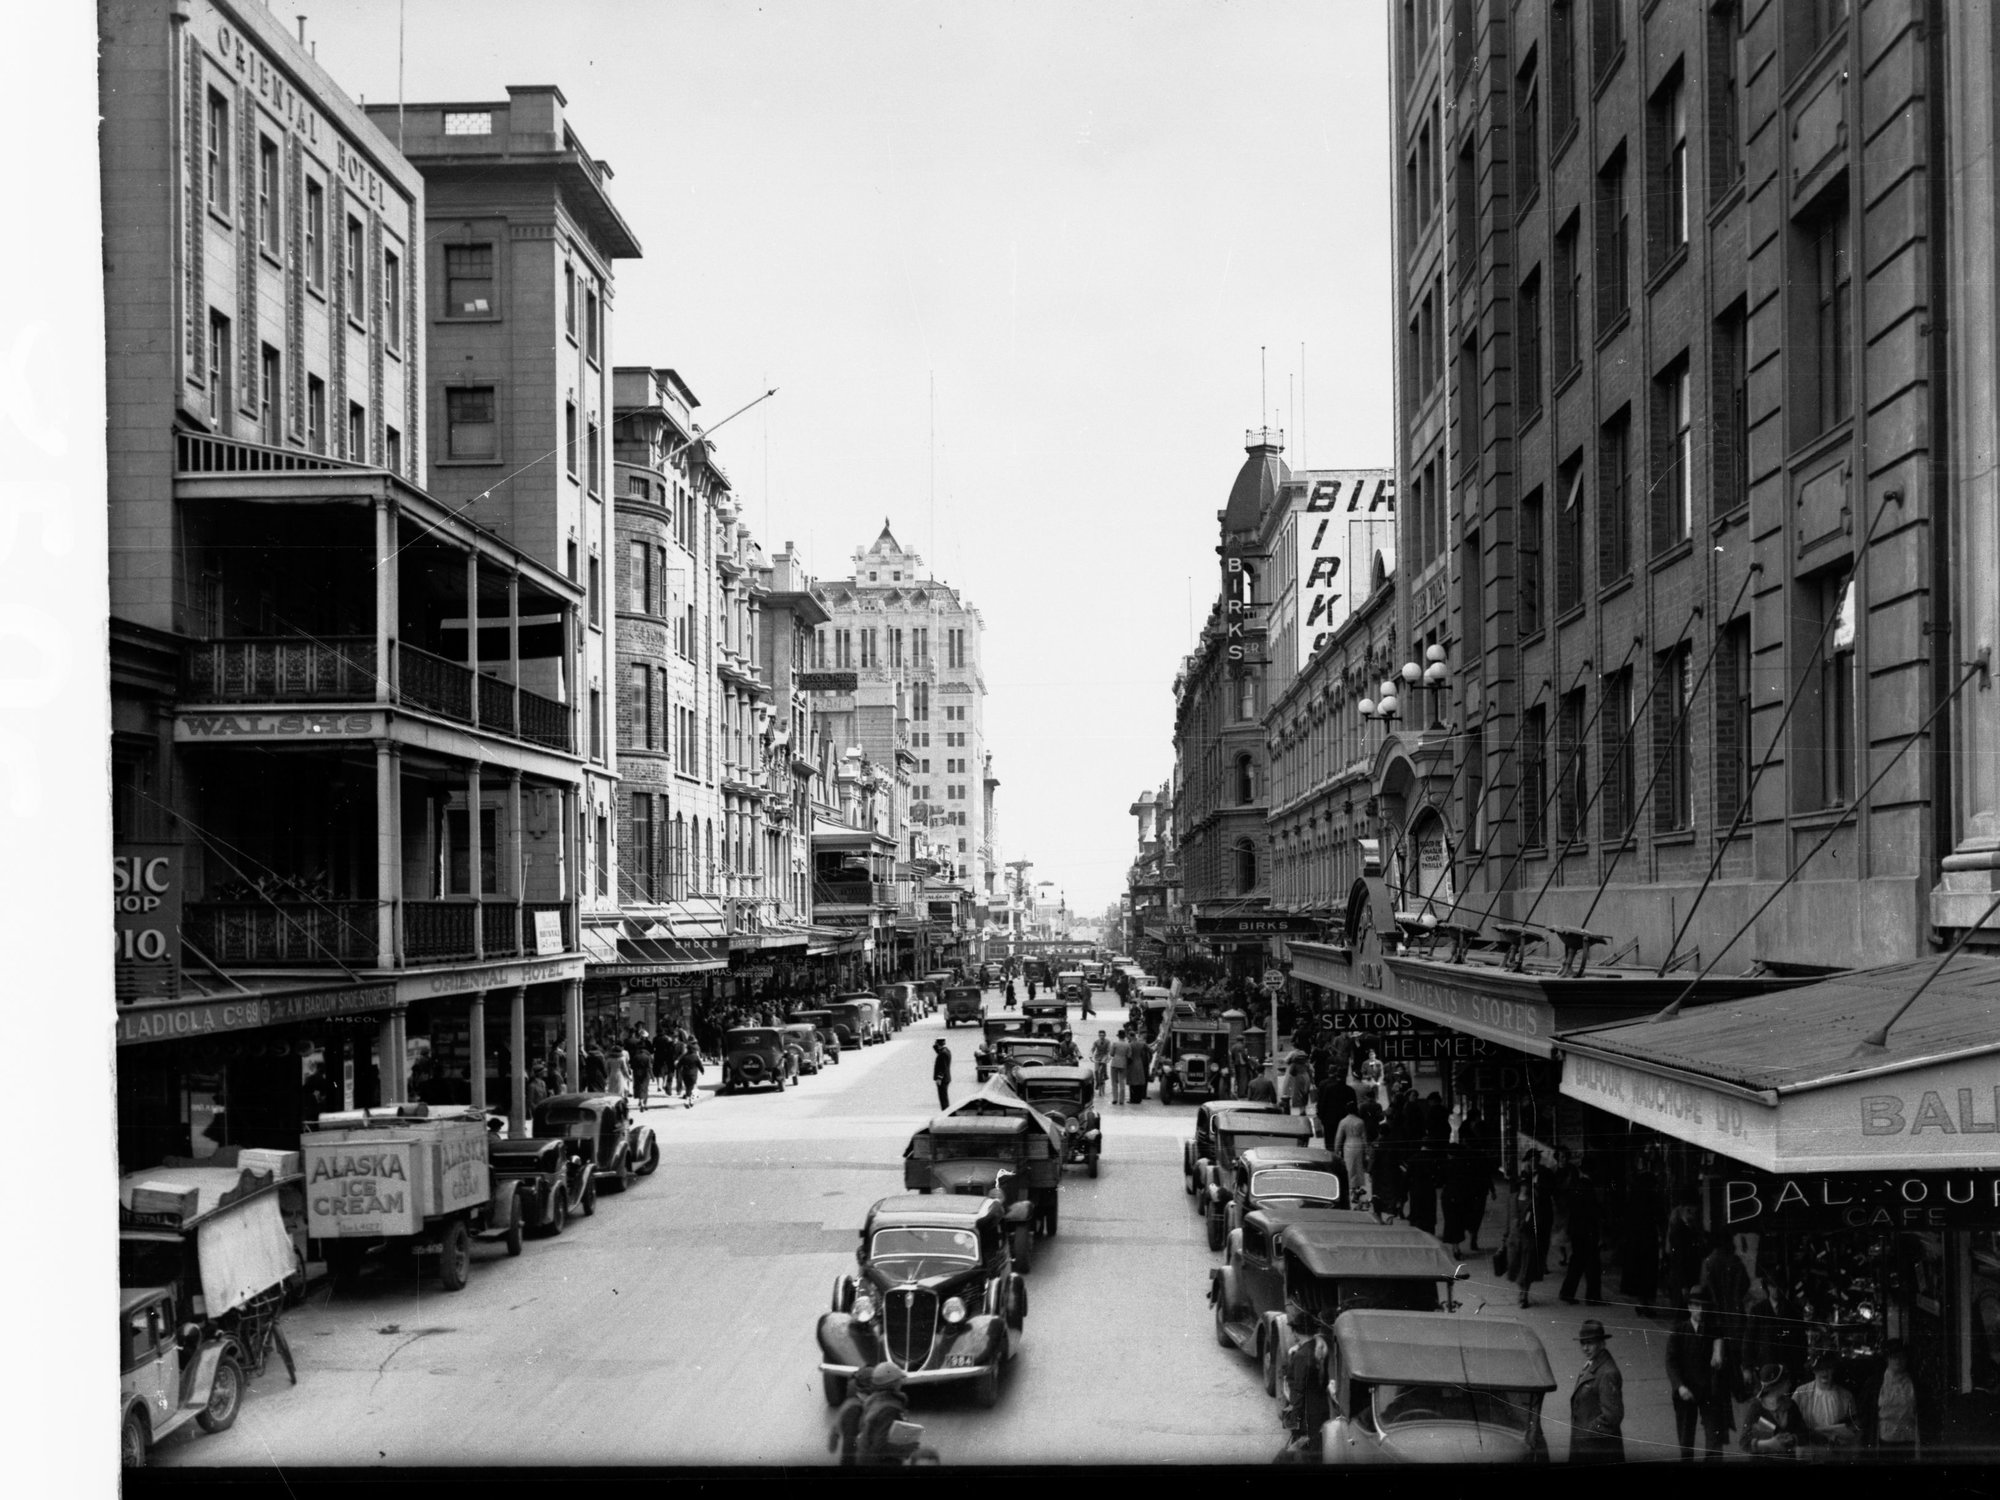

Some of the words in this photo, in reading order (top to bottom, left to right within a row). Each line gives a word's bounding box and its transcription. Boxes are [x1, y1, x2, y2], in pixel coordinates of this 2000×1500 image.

[217, 26, 318, 145] ORIENTAL
[336, 139, 387, 212] HOTEL
[1227, 557, 1244, 660] BIRKS
[182, 714, 373, 736] WALSHS
[1238, 921, 1289, 931] BIRKS
[431, 966, 508, 993] ORIENTAL
[520, 961, 564, 982] HOTEL
[595, 964, 668, 976] CHEMISTS
[629, 976, 681, 988] CHEMISTS
[304, 992, 338, 1015] BARLOW
[1471, 994, 1537, 1035] STORES
[325, 1016, 381, 1024] AMSCOL
[1321, 1012, 1413, 1030] SEXTONS
[1860, 1085, 2000, 1136] BAL
[443, 1138, 487, 1176] ALASKA
[310, 1154, 408, 1186] ALASKA
[341, 1179, 377, 1198] ICE
[313, 1191, 404, 1217] CREAM
[1844, 1207, 1948, 1227] CAFE
